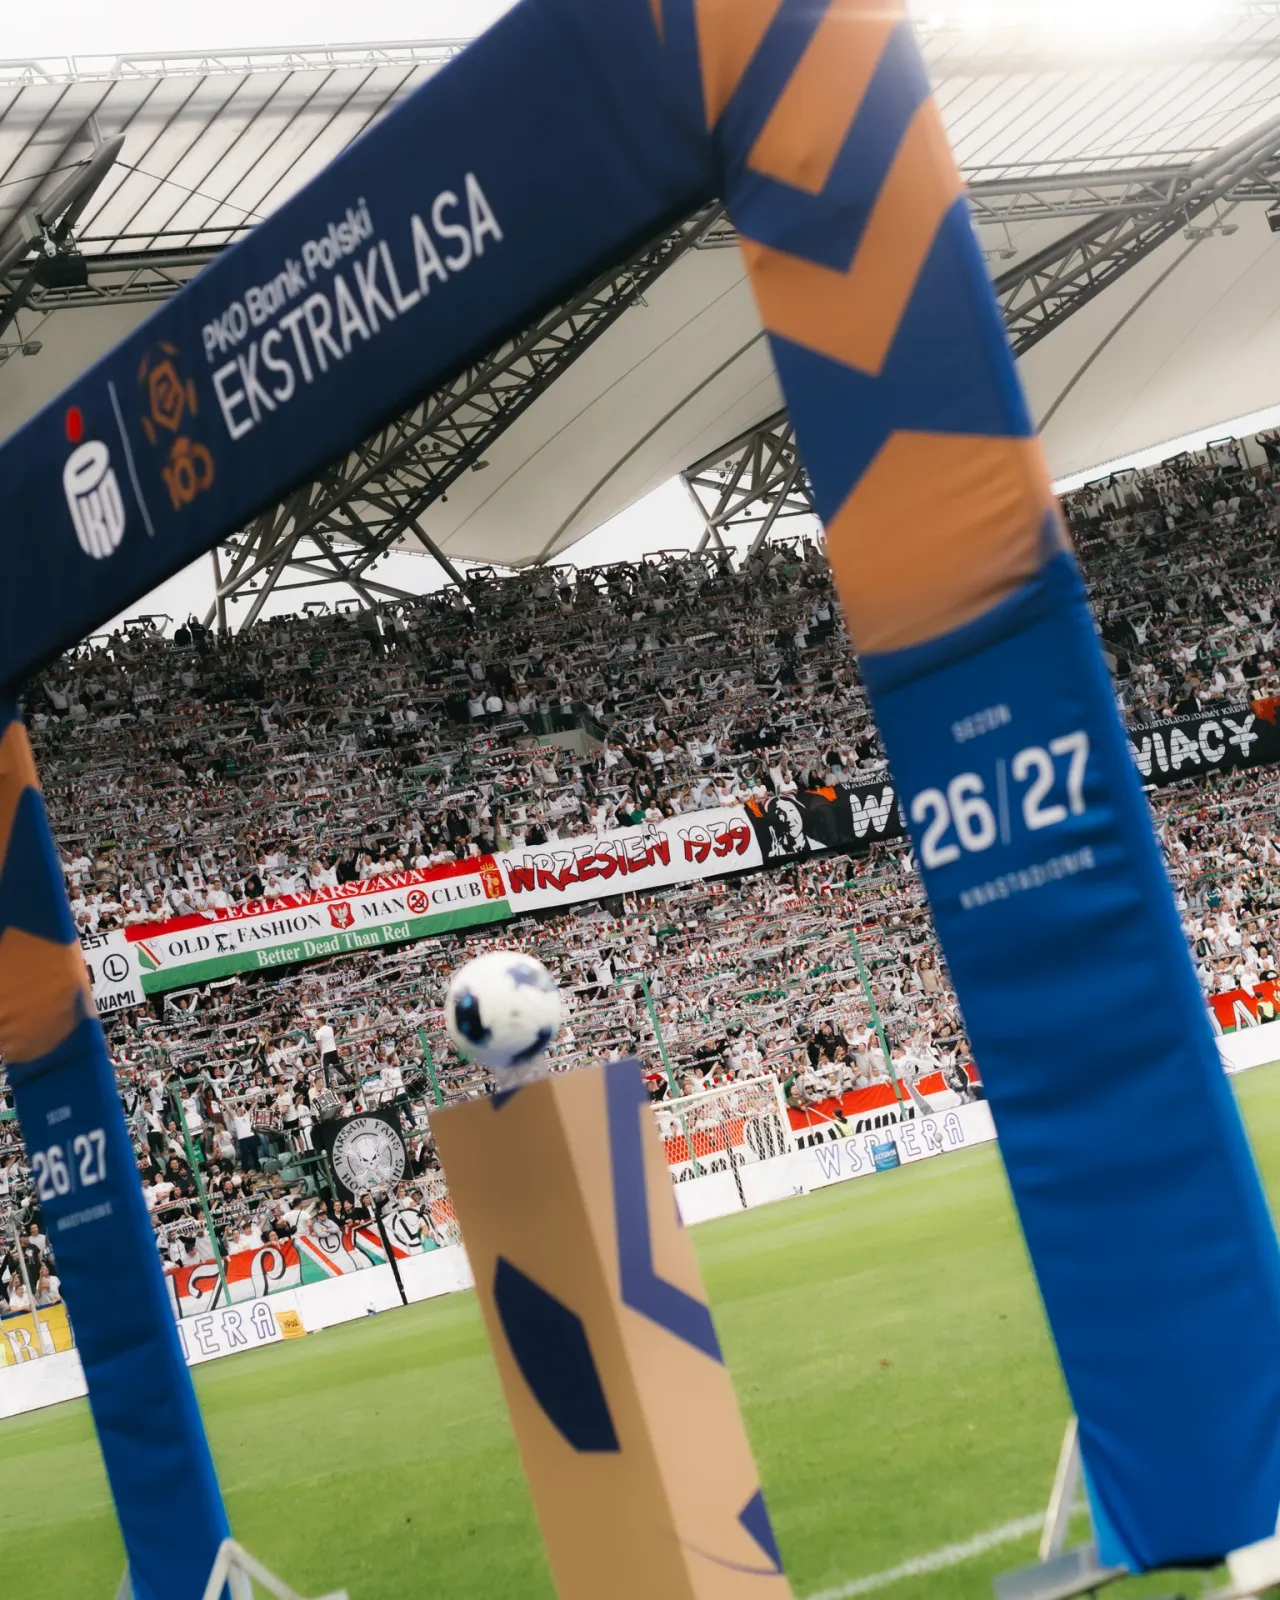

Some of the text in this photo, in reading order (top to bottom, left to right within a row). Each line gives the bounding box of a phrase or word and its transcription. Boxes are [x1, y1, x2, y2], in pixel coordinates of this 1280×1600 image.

[202, 196, 374, 363] PKO Bank Polski
[212, 171, 504, 440] EKSTRAKLASA
[678, 817, 751, 864] 1939
[212, 871, 426, 922] LEGIA WARSZAWA
[361, 882, 482, 918] MAN CLUB
[168, 912, 322, 957] OLD FASHION
[256, 922, 411, 967] Better Dead Than Red
